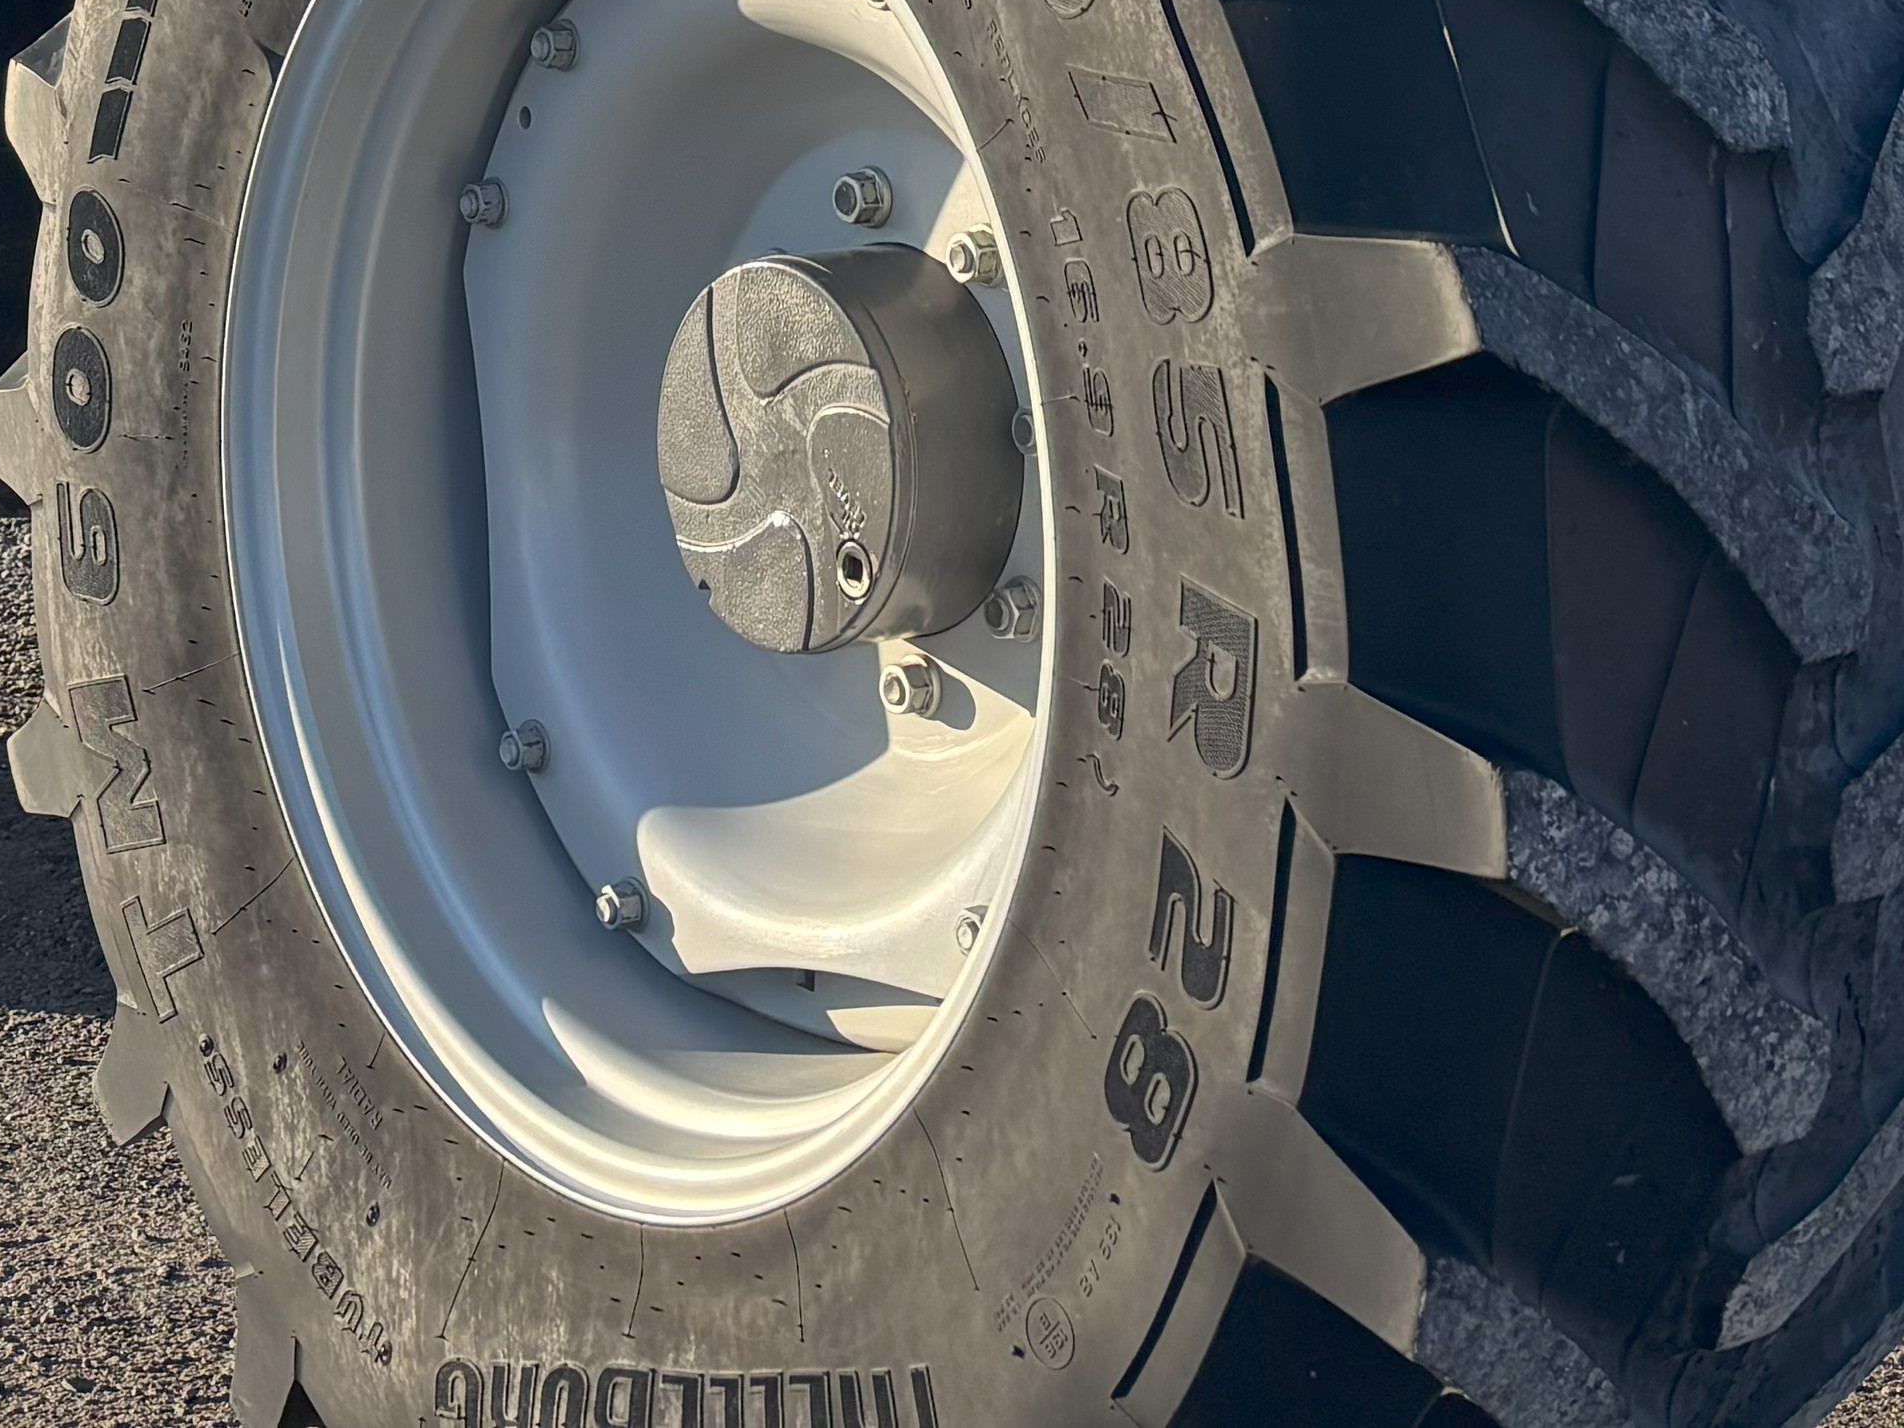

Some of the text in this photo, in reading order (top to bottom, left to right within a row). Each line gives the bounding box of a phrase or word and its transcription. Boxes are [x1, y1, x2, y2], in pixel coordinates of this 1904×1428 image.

[336, 1055, 384, 1131] RADIAL
[1104, 824, 1234, 1172] 28
[203, 1052, 384, 1360] TUBELESS
